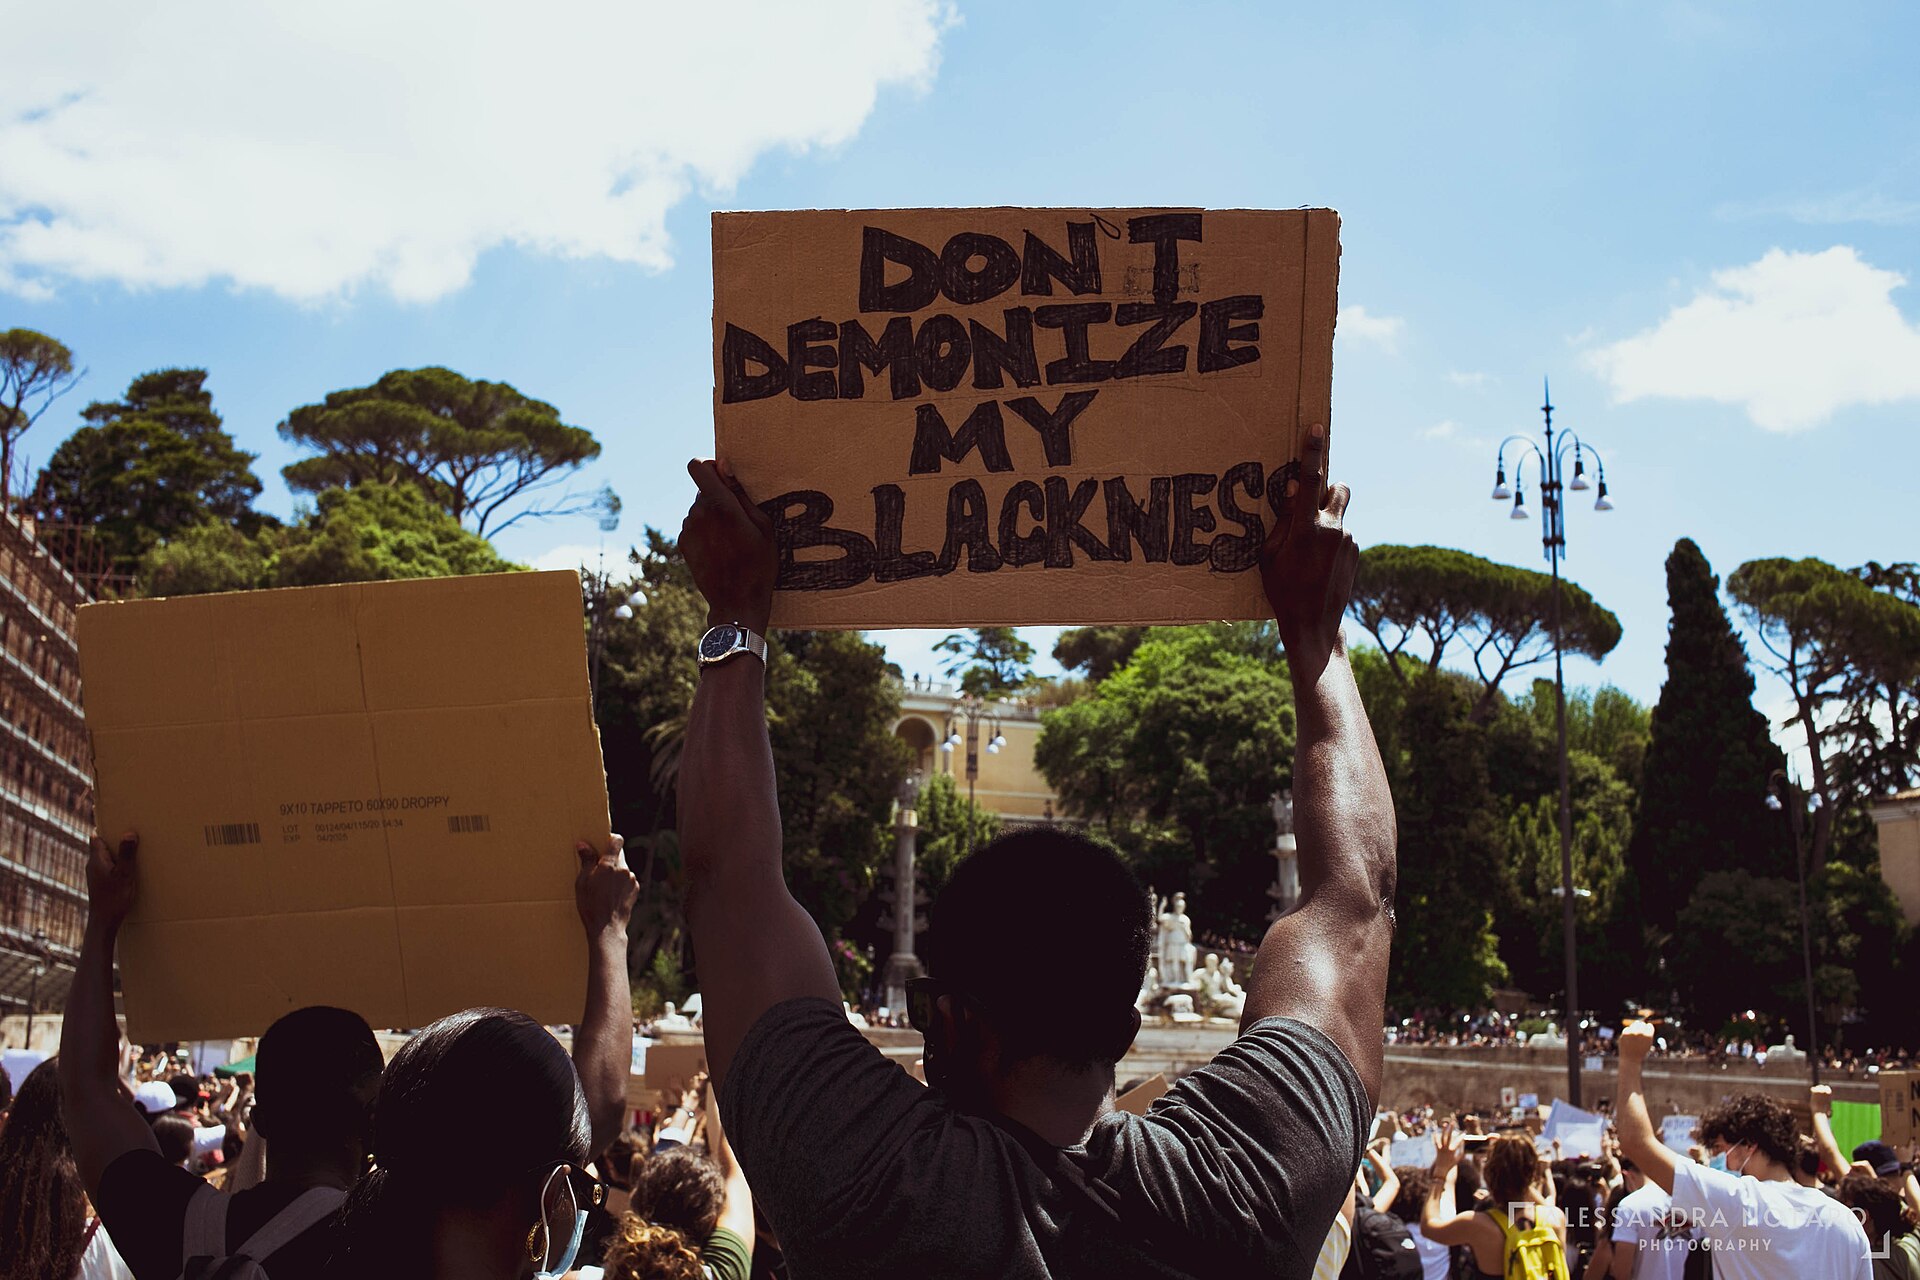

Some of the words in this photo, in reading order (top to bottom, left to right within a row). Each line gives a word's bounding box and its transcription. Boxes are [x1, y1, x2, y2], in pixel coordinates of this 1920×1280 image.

[859, 213, 1202, 313] DON'T
[722, 295, 1263, 403] DEMONIZE
[909, 391, 1098, 476] MY
[279, 802, 307, 816] 9X10
[311, 799, 363, 815] TAPPETO
[367, 797, 399, 811] 60X90
[402, 795, 450, 810] DROPPY
[282, 824, 299, 833] LOT
